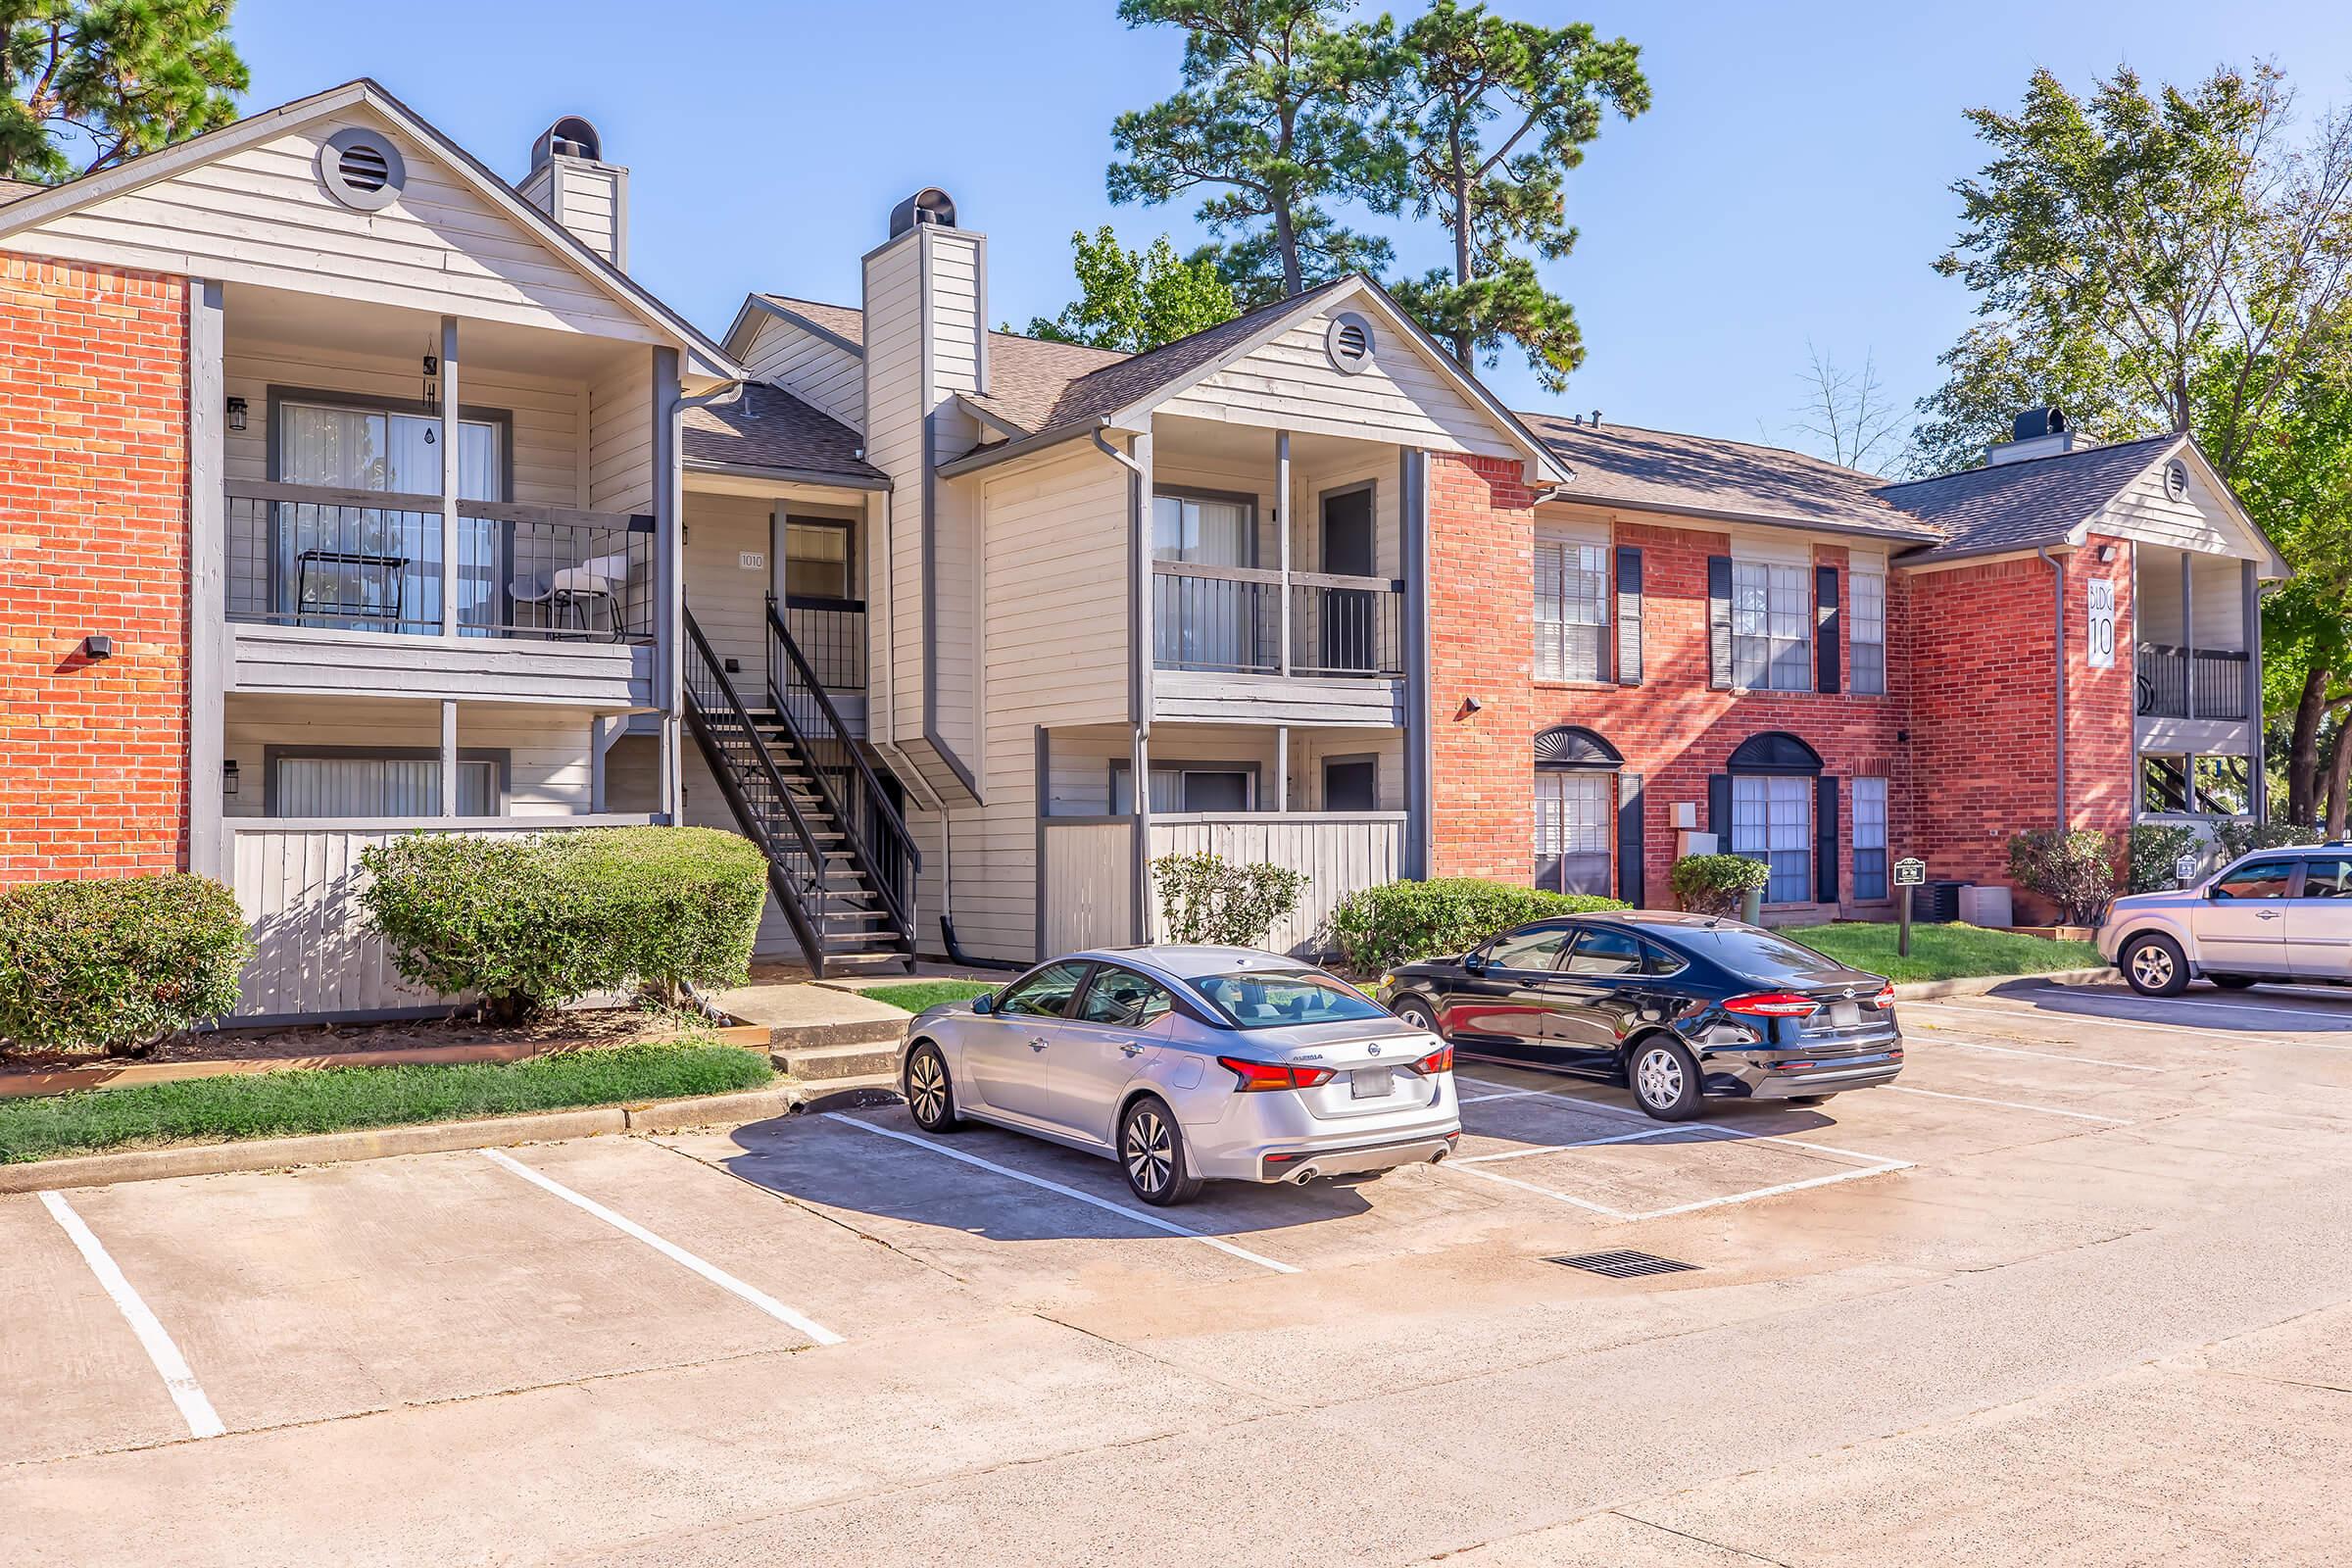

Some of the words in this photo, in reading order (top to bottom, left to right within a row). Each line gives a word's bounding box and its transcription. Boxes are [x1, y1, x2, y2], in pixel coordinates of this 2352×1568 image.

[742, 555, 762, 567] 1010
[2089, 586, 2113, 612] BLDG
[2090, 617, 2112, 655] 10
